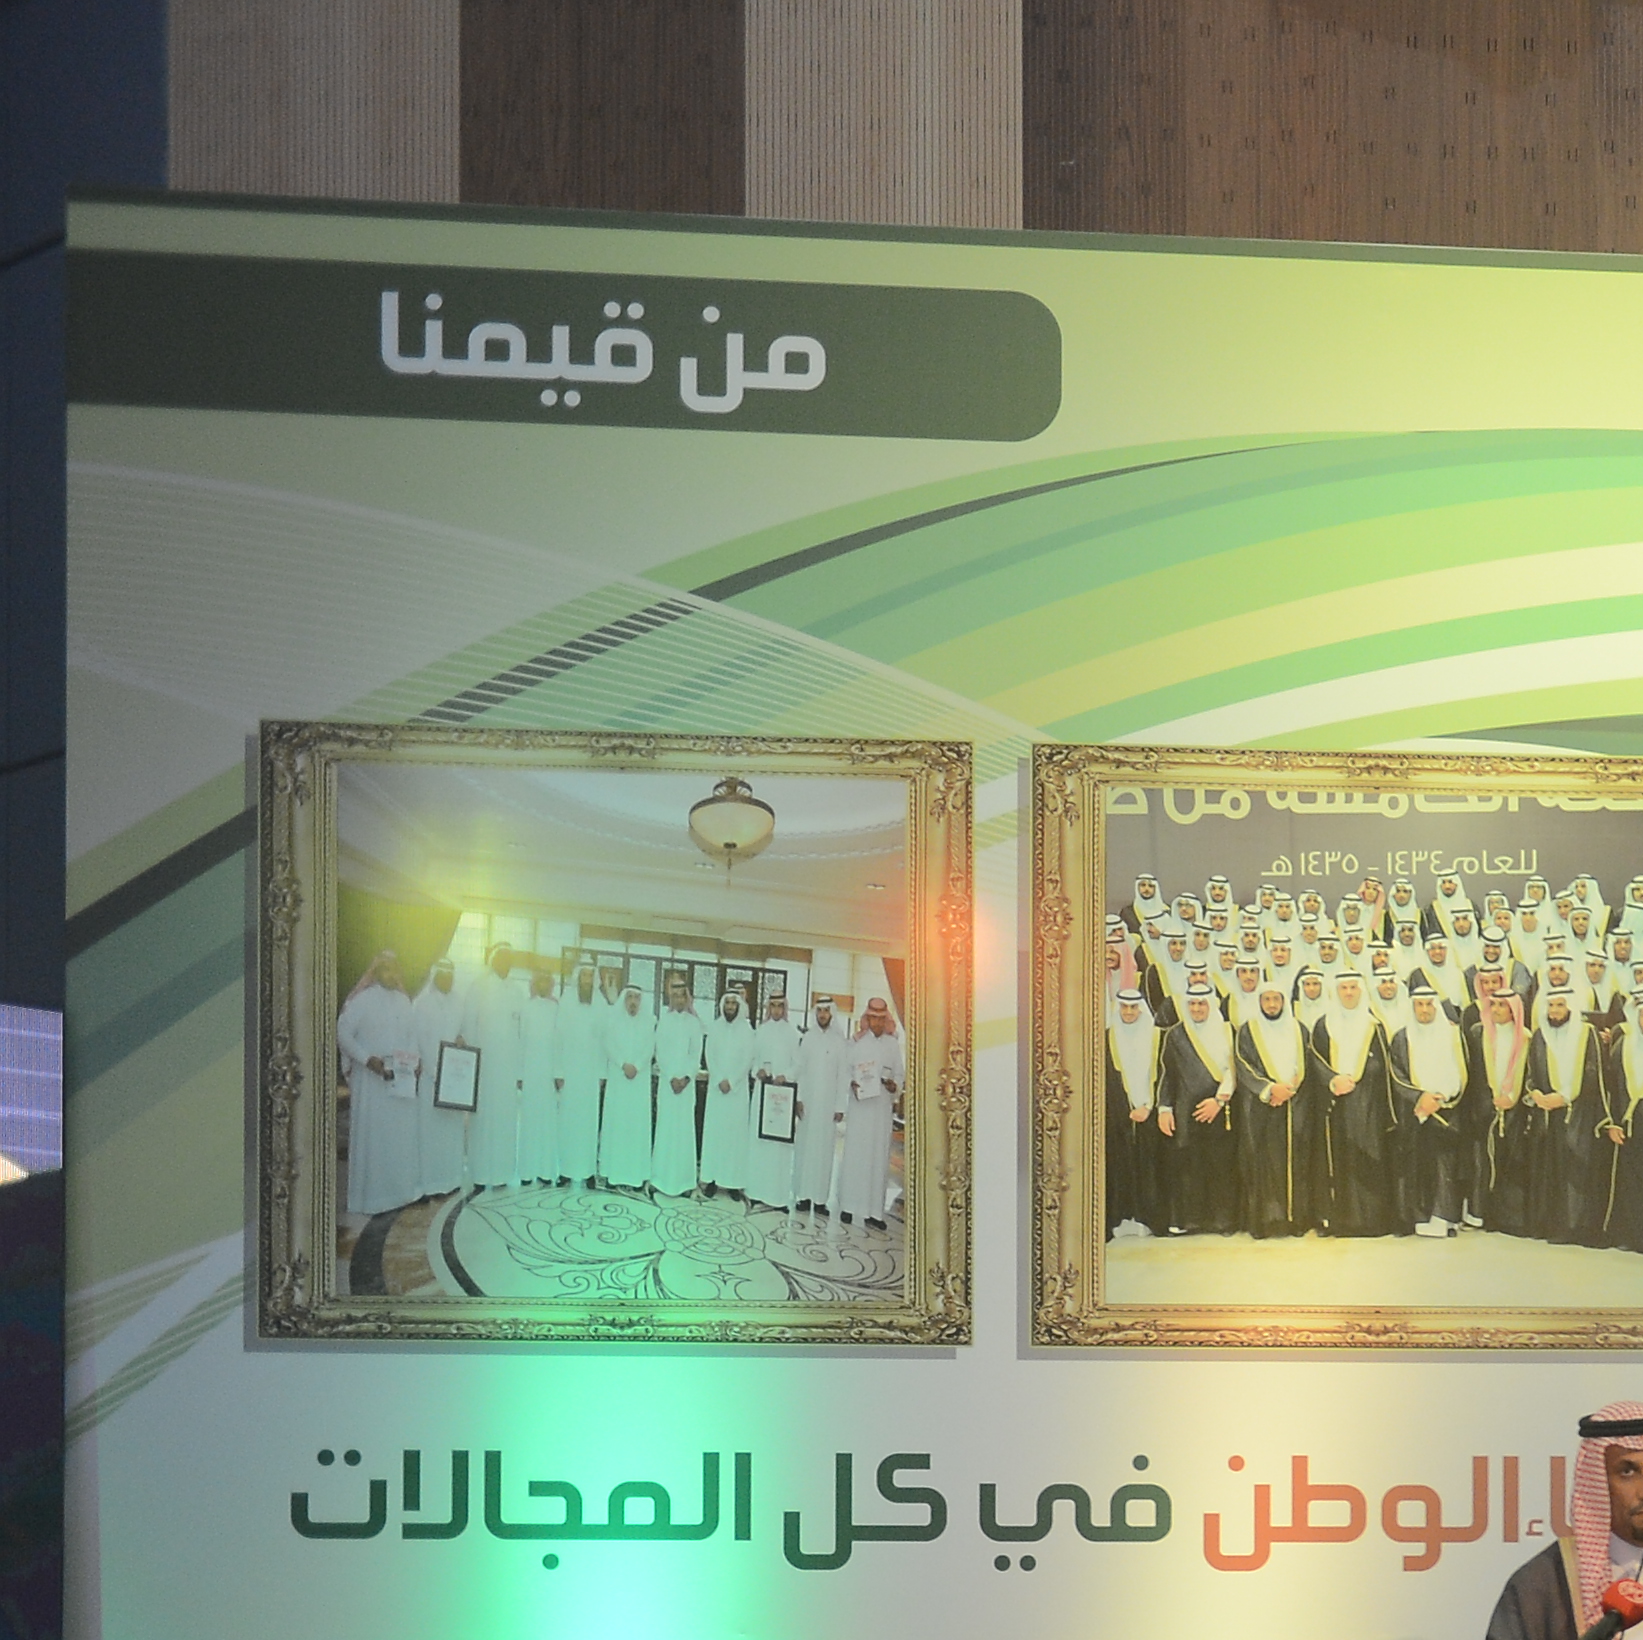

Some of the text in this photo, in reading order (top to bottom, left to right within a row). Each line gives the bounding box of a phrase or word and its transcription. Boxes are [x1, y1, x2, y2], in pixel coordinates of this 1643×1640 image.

[379, 290, 827, 413] من قيمنا
[1452, 849, 1538, 875] للعام
[289, 1448, 753, 1571] المجالات
[781, 1453, 949, 1572] كل
[978, 1453, 1174, 1573] في
[1200, 1454, 1520, 1573] الوطن
